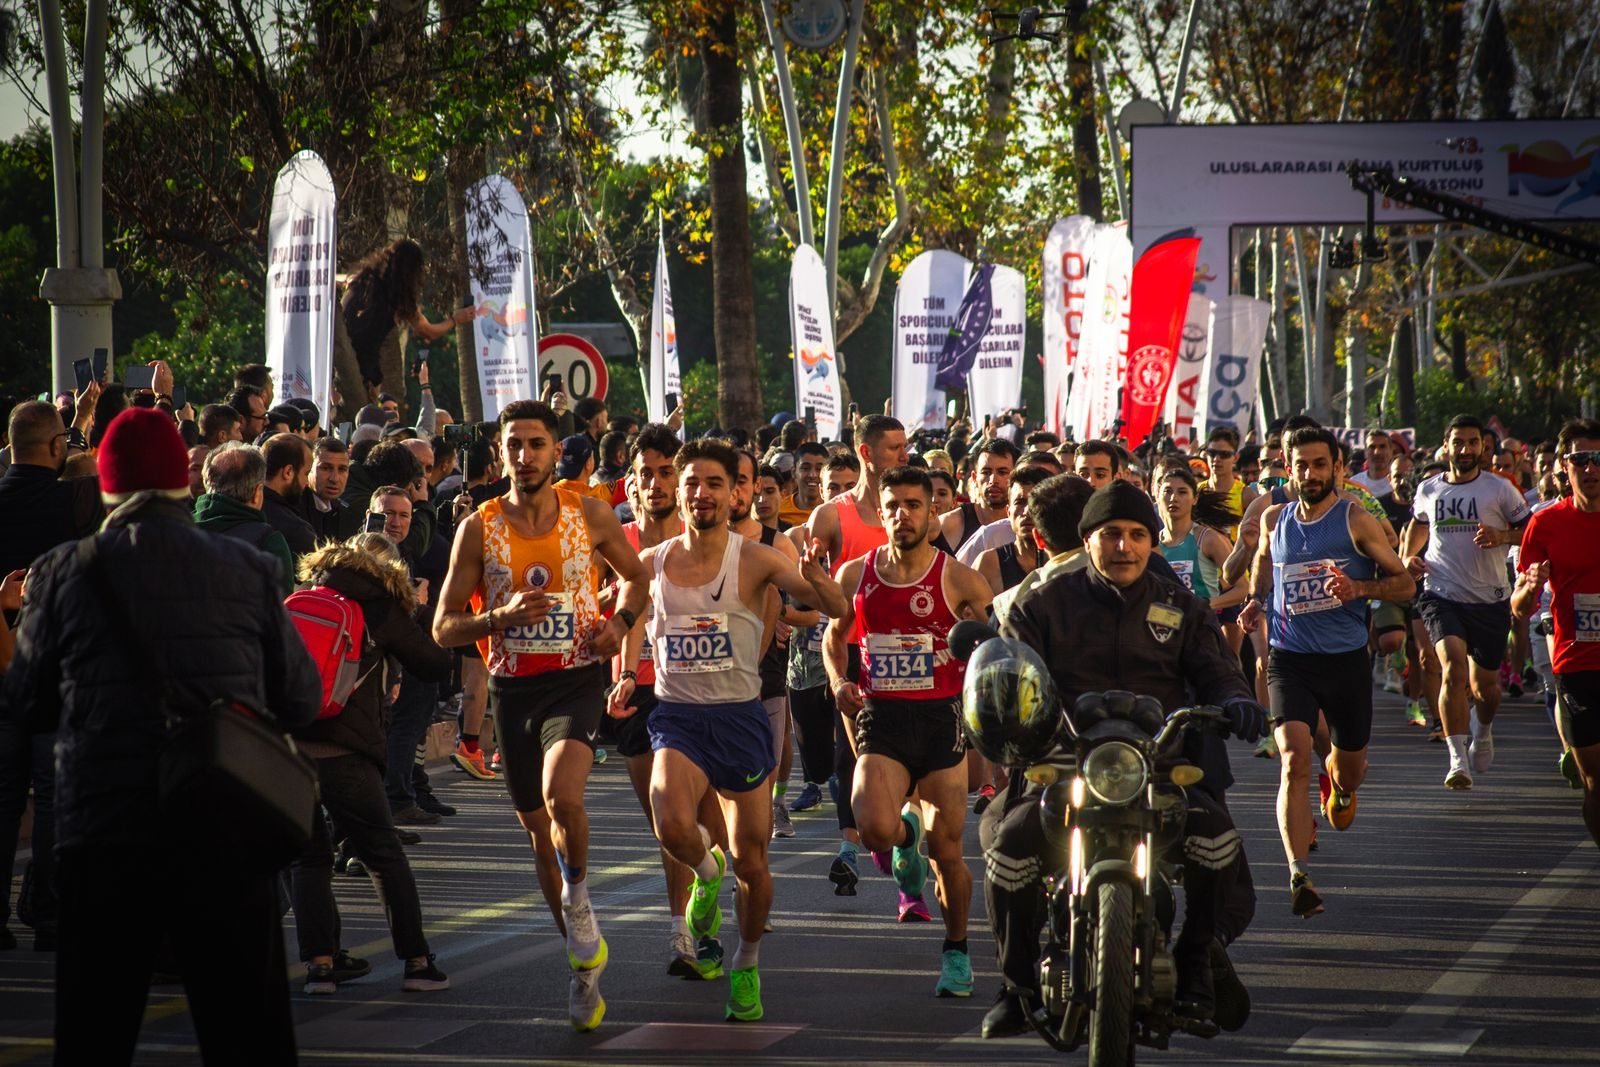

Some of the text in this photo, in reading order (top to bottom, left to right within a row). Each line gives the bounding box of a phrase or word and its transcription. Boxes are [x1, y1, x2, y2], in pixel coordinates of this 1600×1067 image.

[1210, 159, 1484, 174] ULUSLARARASI AANA KURTULUŞ
[923, 296, 945, 310] TÜM
[900, 315, 954, 328] SPORCULA
[987, 323, 1023, 336] CULARA
[905, 334, 946, 347] BAŞARI
[540, 358, 591, 401] 60
[670, 635, 729, 659] 3002
[875, 655, 927, 677] 3134
